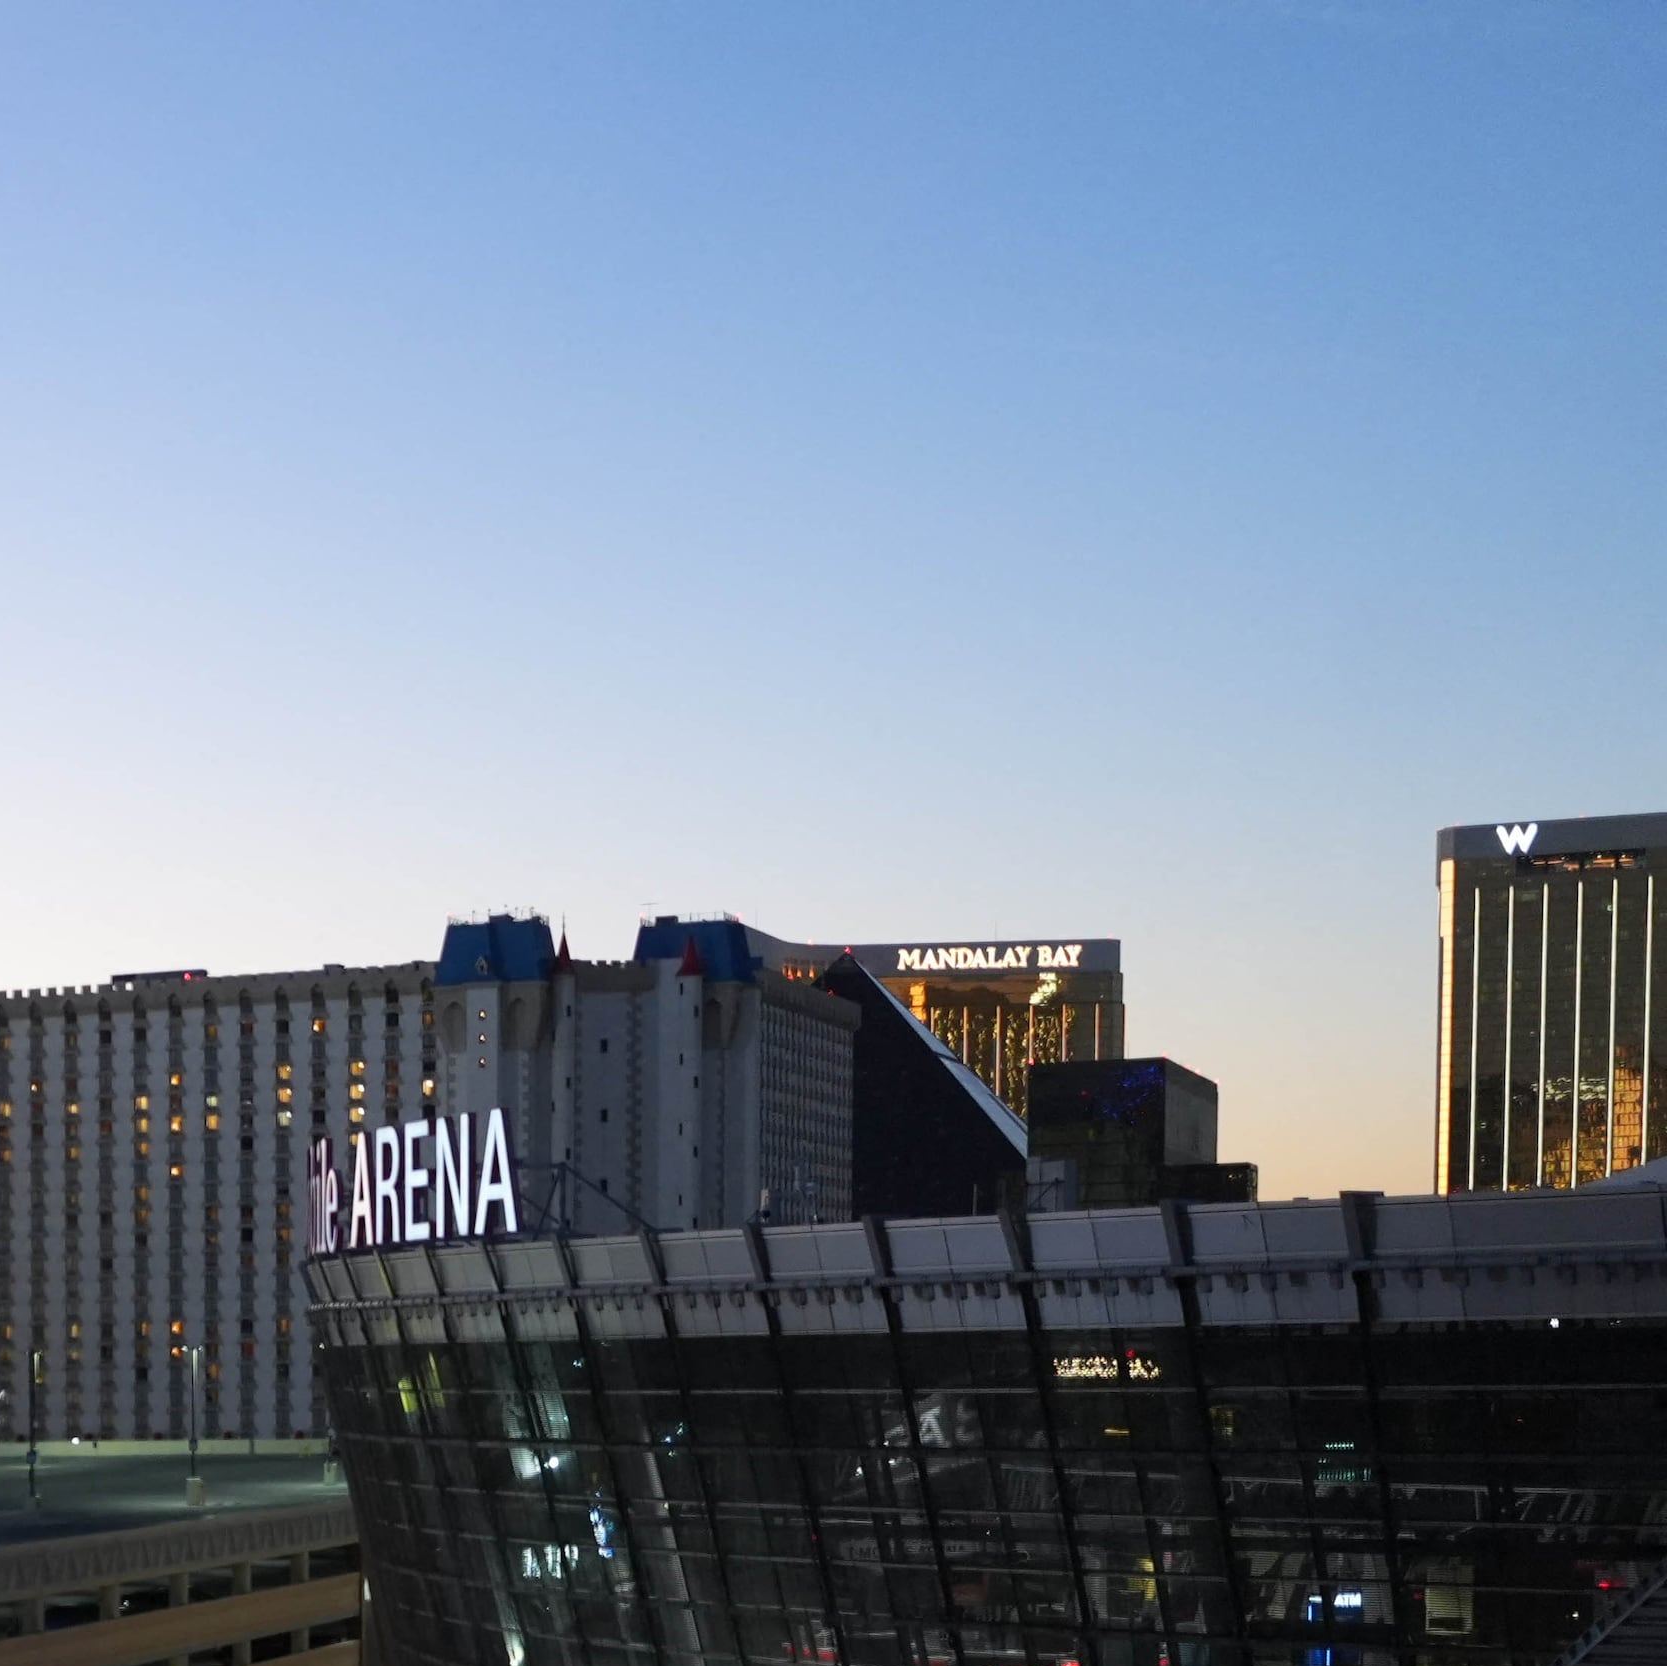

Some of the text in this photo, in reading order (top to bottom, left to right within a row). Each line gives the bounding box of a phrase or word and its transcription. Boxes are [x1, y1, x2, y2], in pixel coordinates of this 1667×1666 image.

[1496, 822, 1538, 856] W
[897, 944, 1083, 971] MANDALAY BAY
[349, 1107, 518, 1249] ARENA
